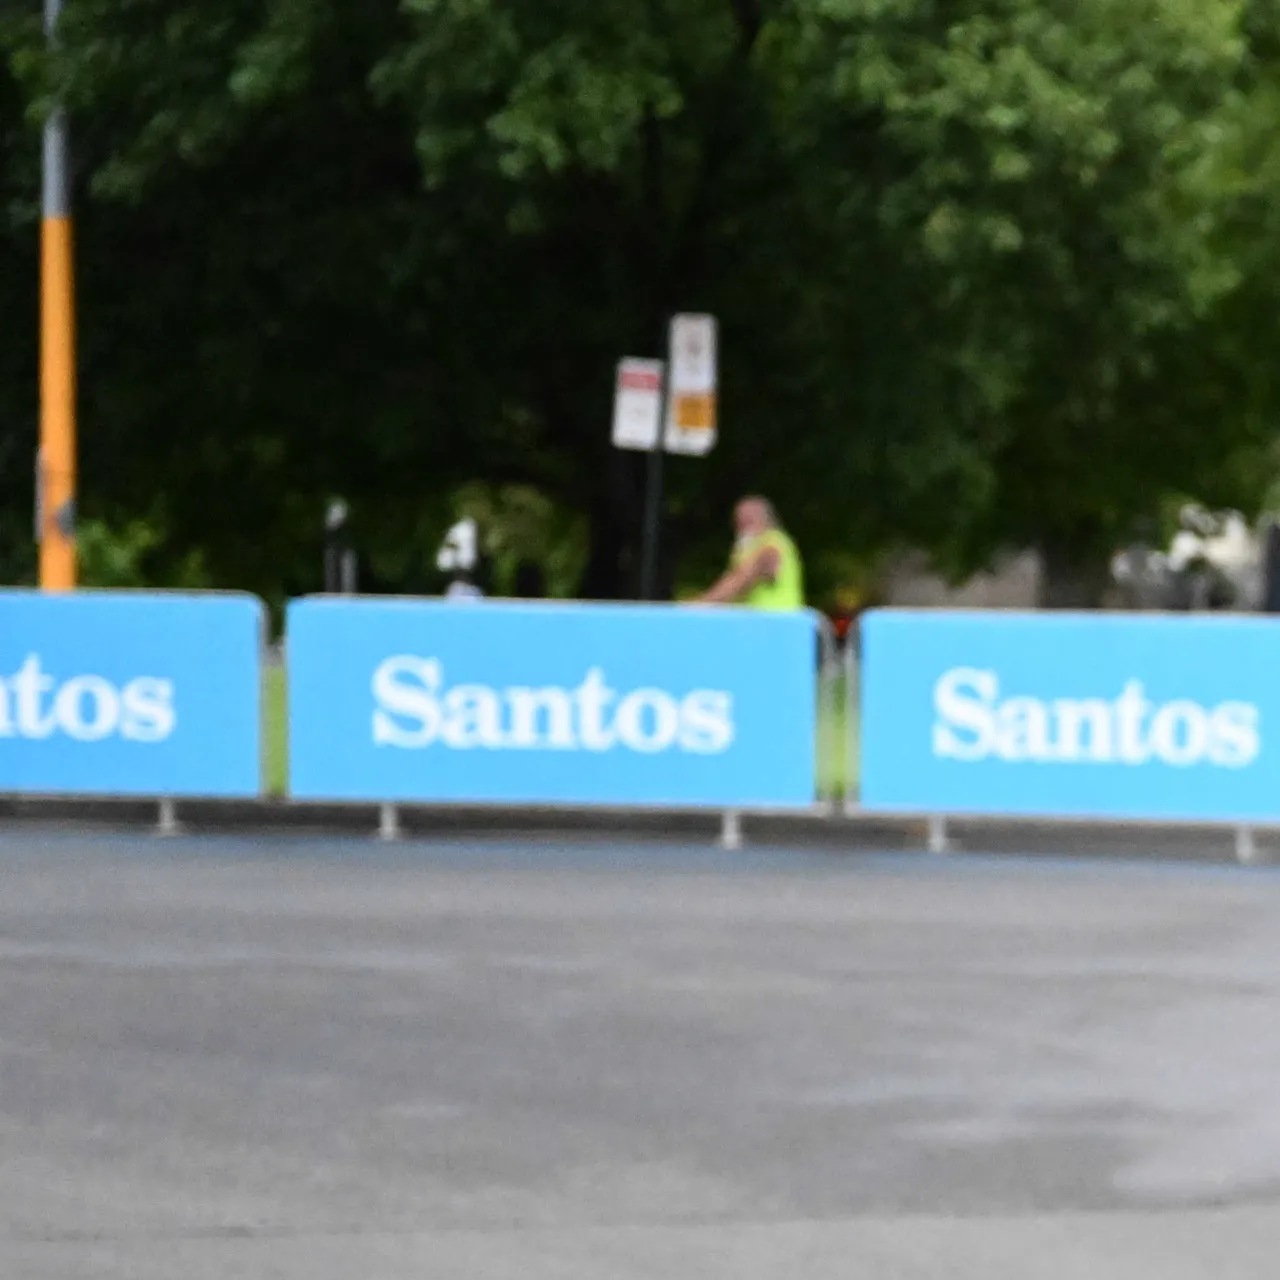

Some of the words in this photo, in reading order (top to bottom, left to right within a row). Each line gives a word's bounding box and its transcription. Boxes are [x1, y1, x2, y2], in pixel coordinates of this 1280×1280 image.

[0, 652, 177, 741] tos
[371, 654, 733, 754] Santos
[932, 666, 1260, 768] Santos
